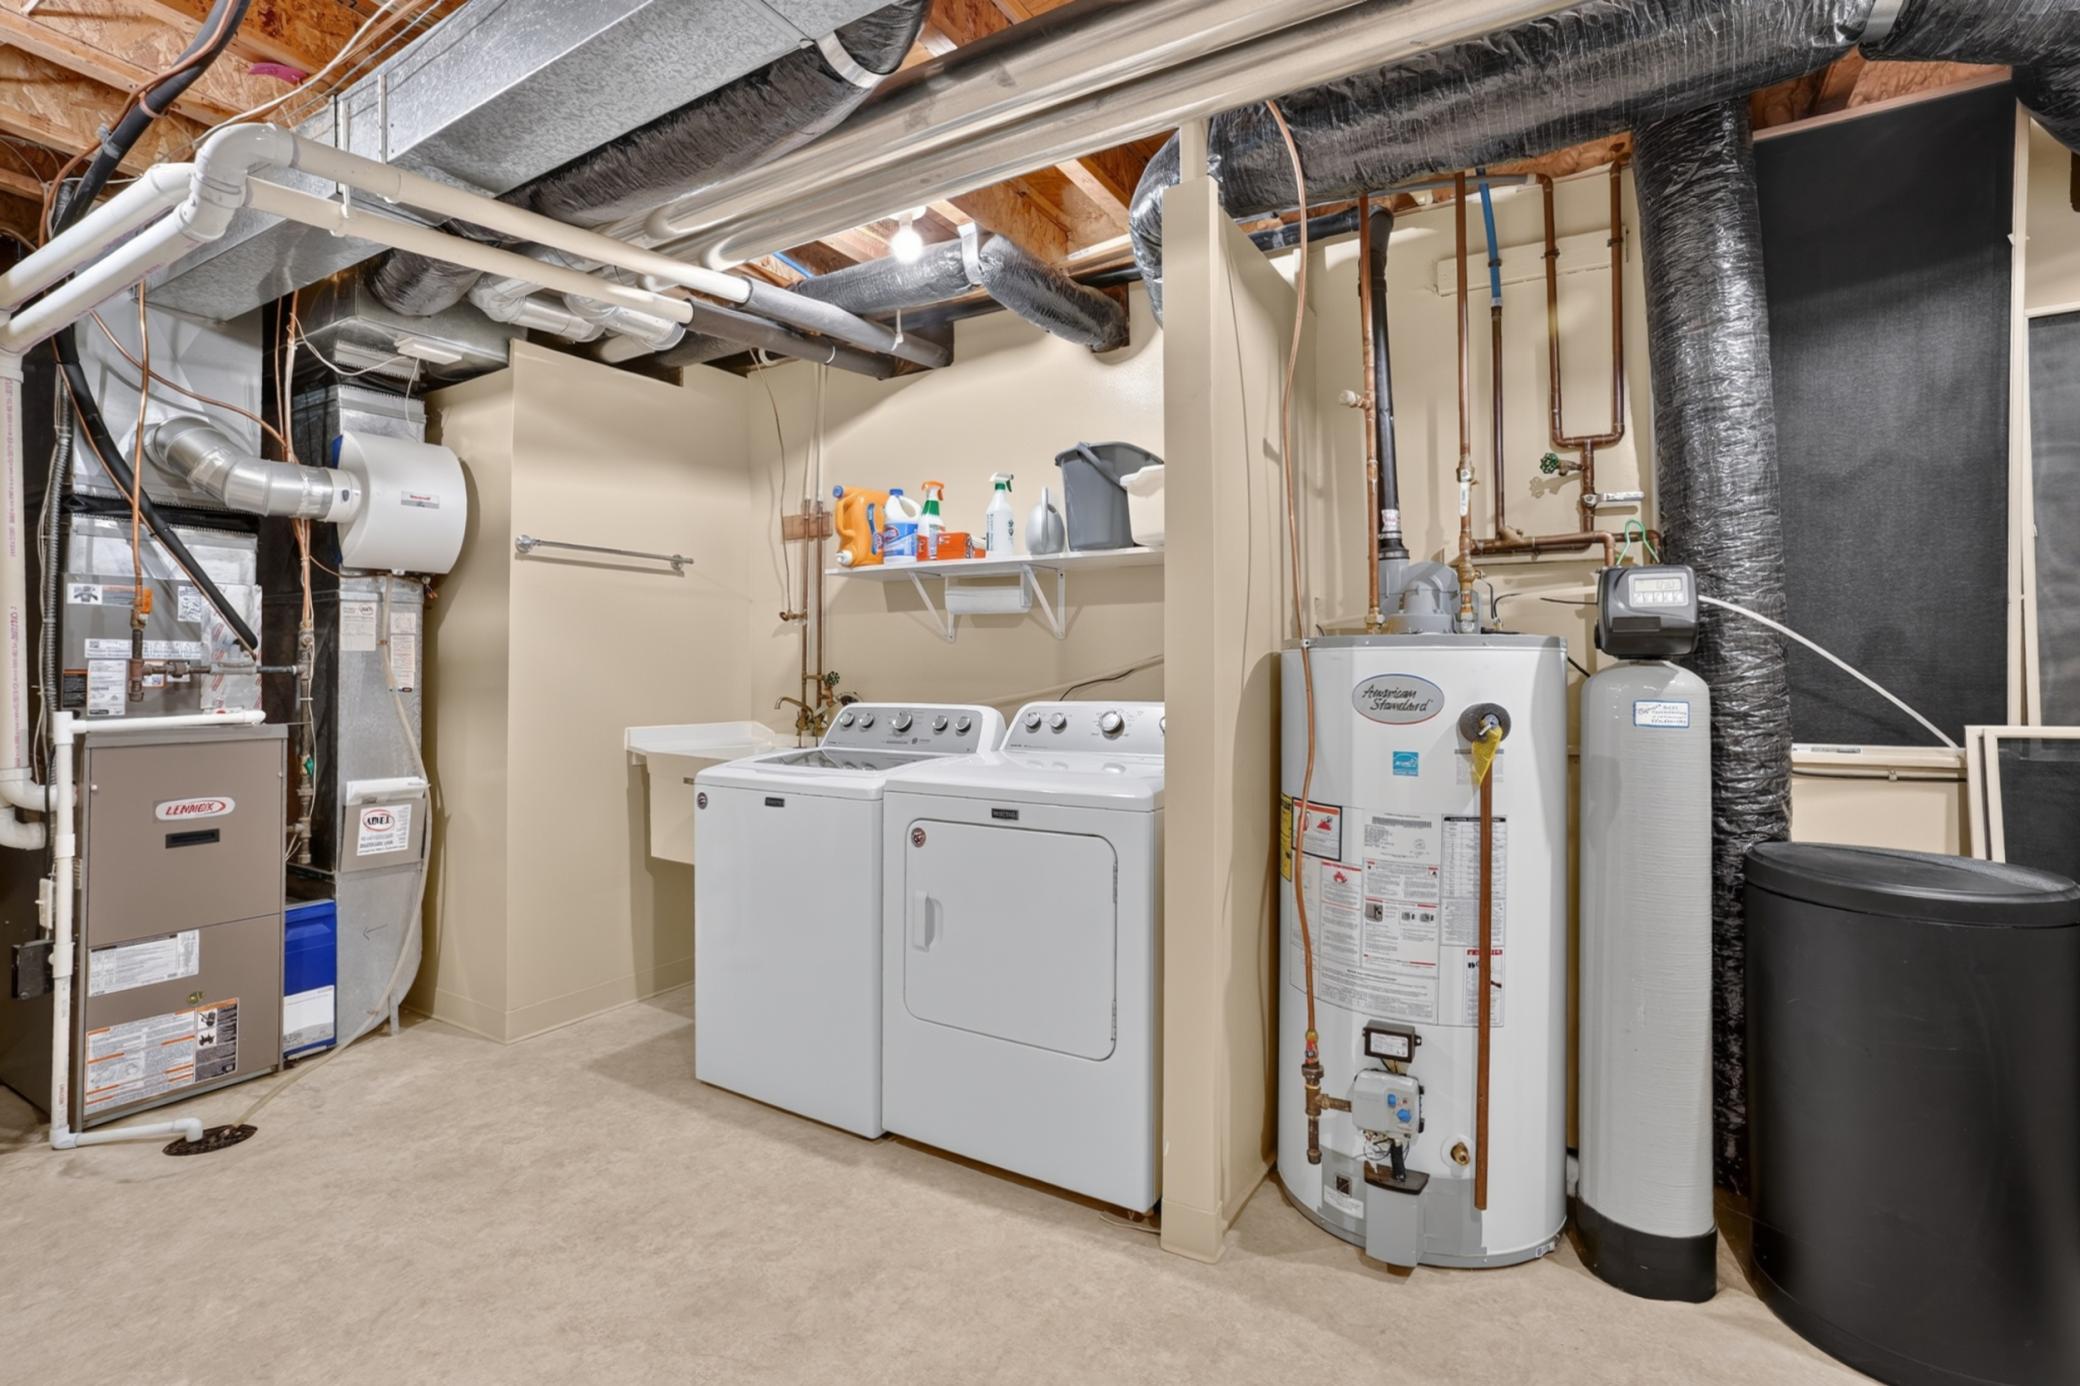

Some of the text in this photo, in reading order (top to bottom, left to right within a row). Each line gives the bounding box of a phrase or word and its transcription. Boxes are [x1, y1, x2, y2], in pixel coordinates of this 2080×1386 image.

[1362, 683, 1417, 699] American
[1370, 697, 1431, 712] Standard
[165, 802, 215, 816] LENNOX
